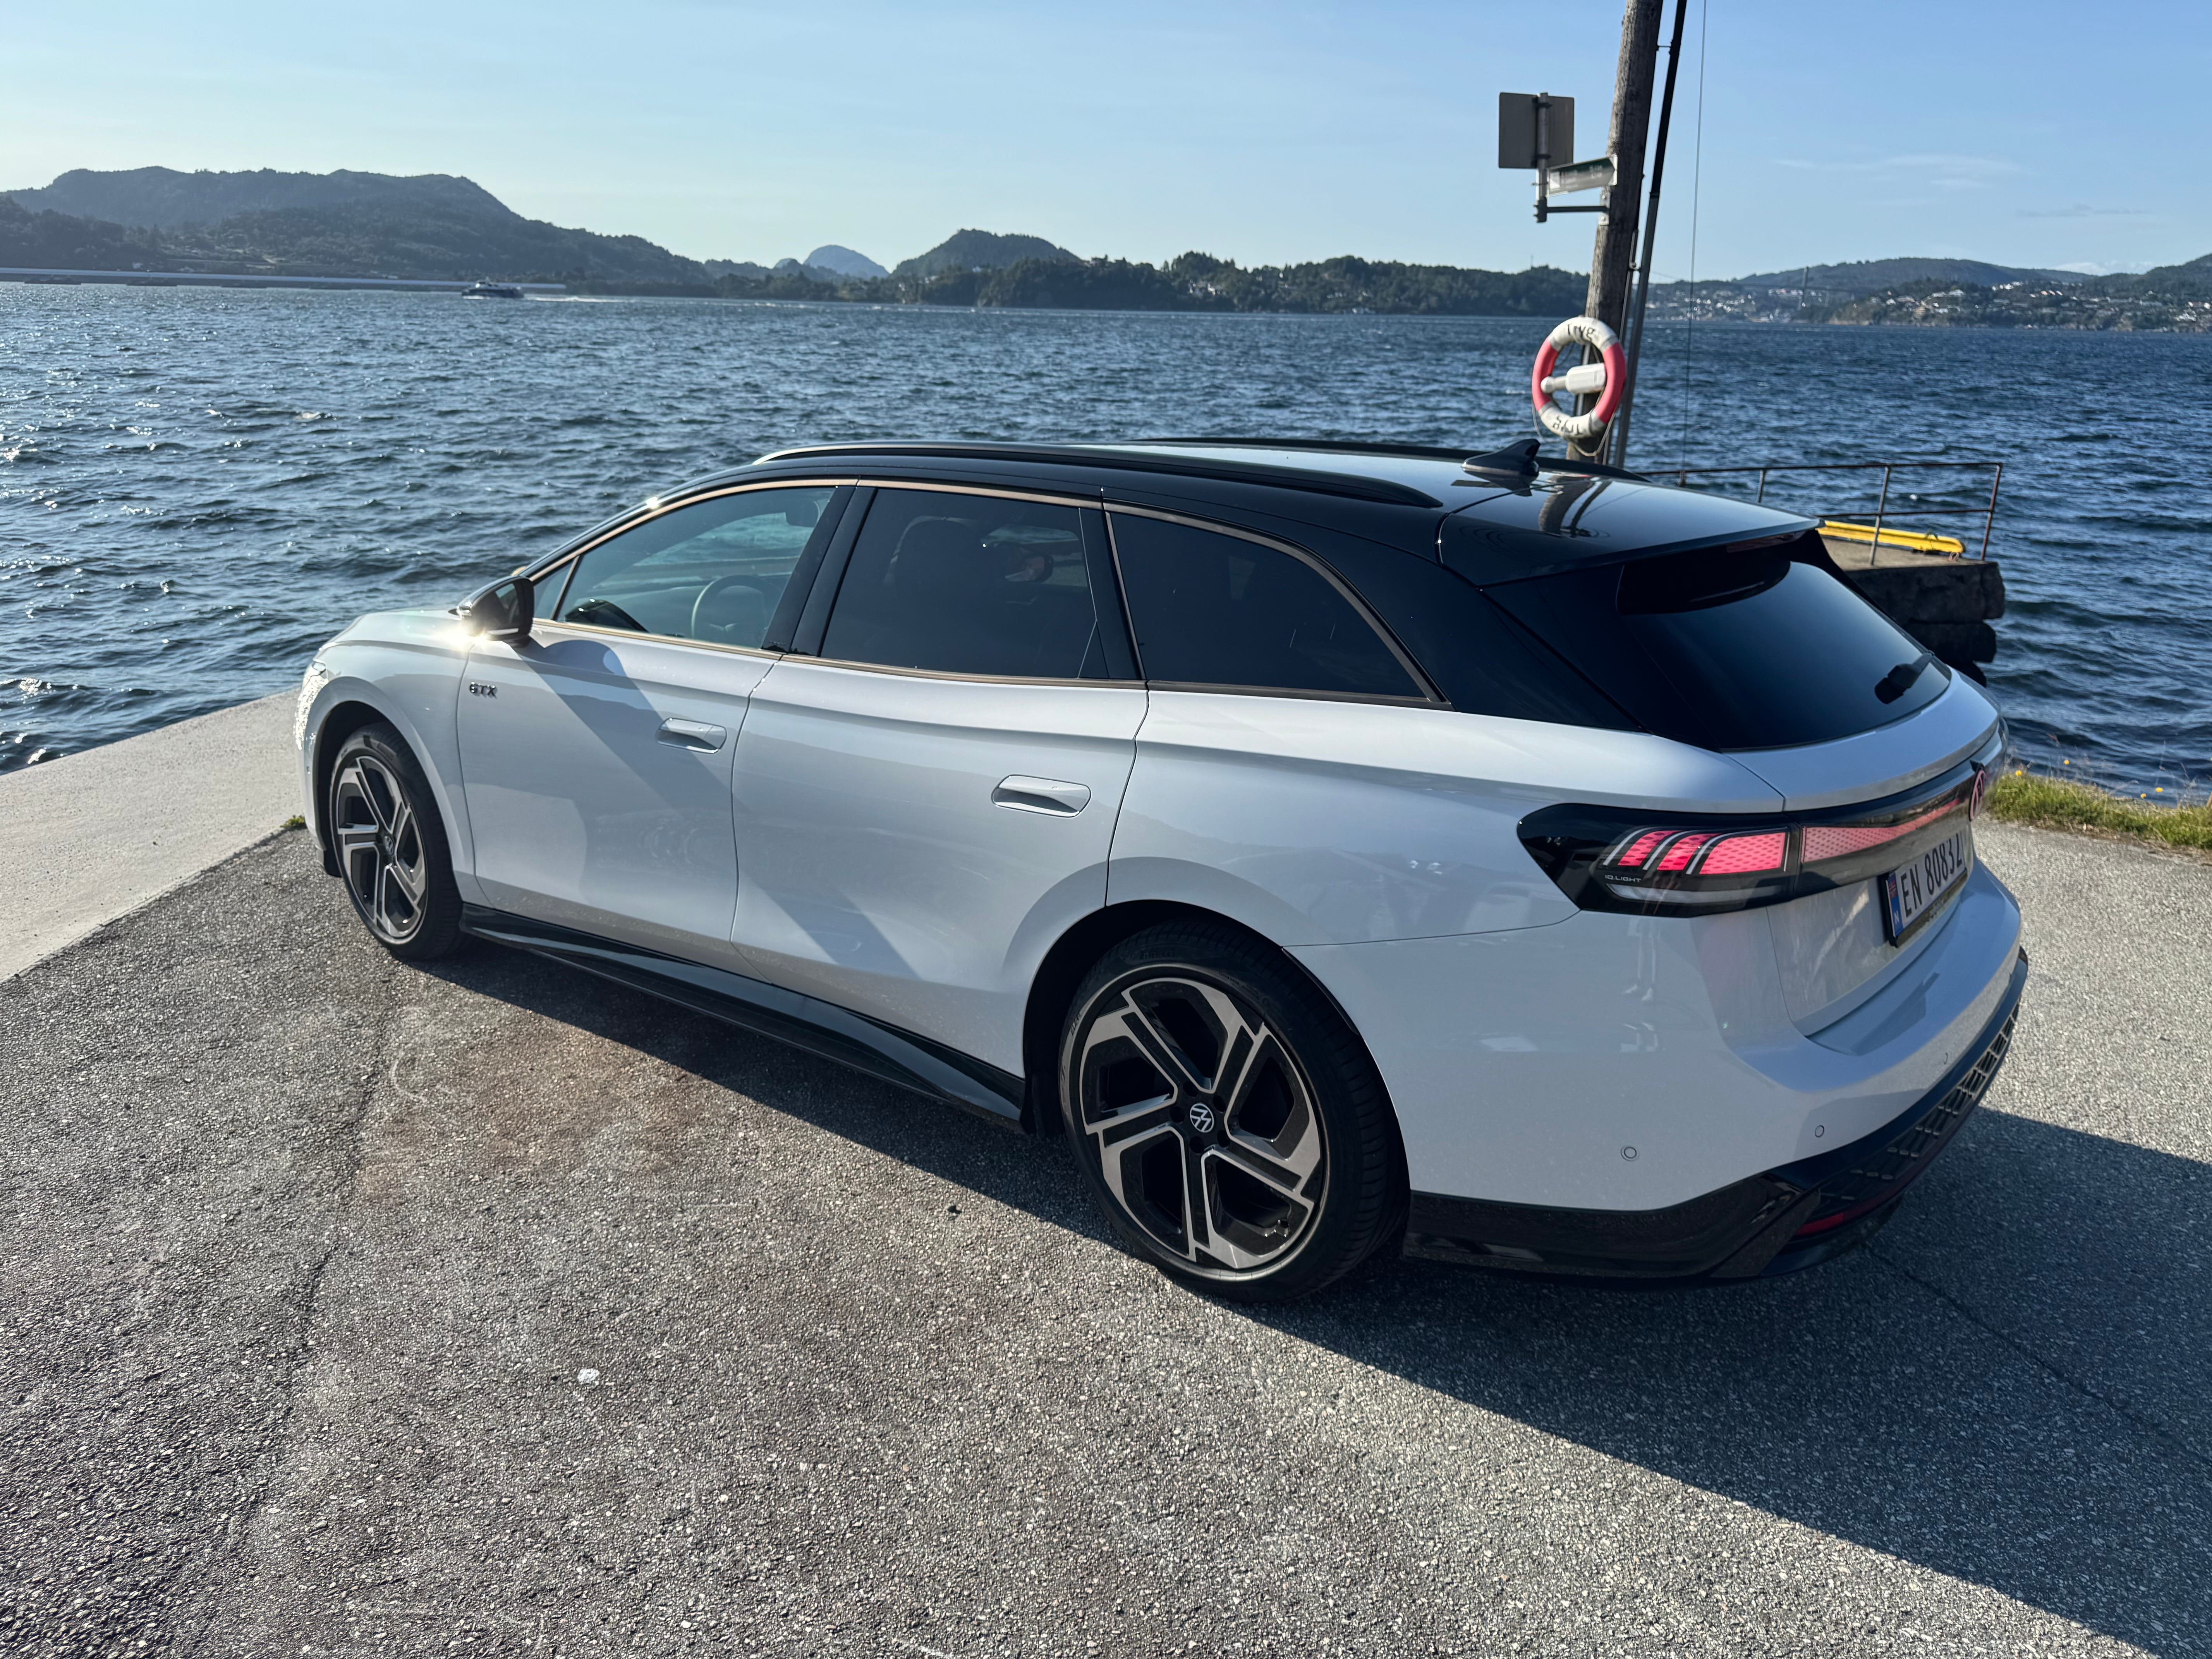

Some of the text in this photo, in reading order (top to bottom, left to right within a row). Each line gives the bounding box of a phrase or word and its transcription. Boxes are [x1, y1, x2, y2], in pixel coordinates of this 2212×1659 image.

[469, 682, 497, 698] GTX
[1901, 833, 1962, 917] EN 80832
[1894, 911, 1899, 925] N
